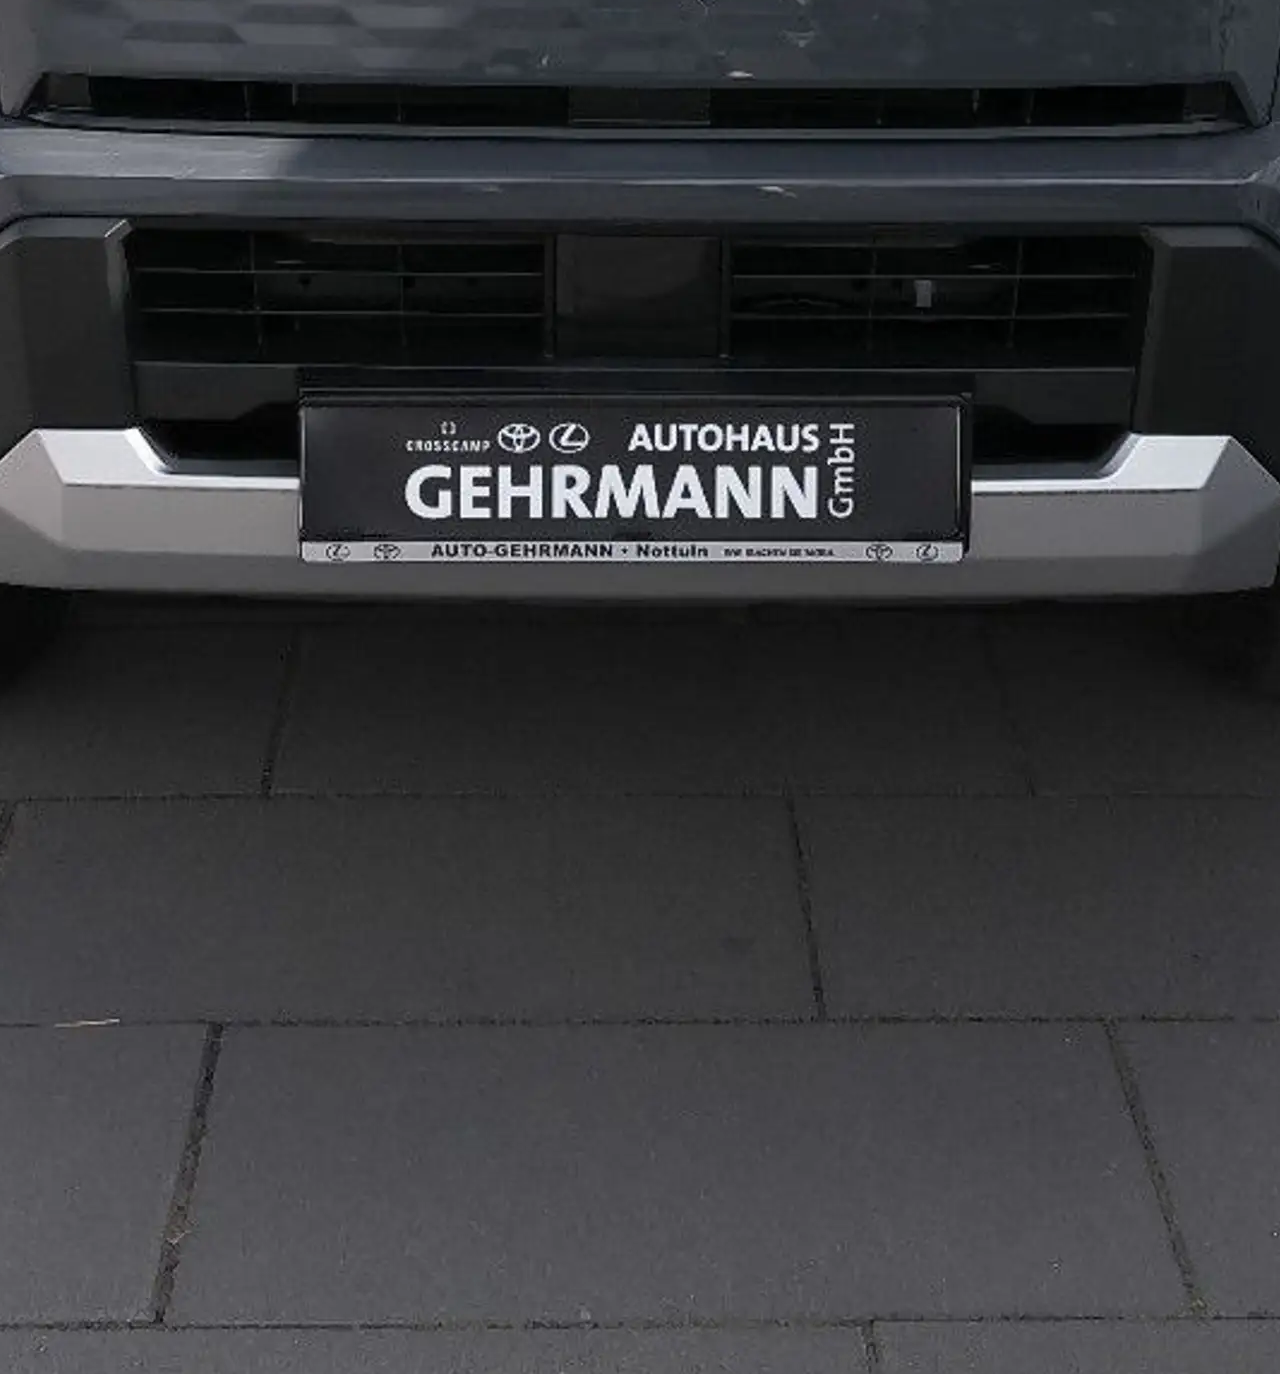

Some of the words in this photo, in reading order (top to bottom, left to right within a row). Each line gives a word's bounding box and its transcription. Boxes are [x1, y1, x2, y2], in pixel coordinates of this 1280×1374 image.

[406, 440, 490, 452] CROSSCAMP
[629, 424, 819, 452] AUTOHAUS
[827, 423, 855, 519] GmbH
[406, 465, 817, 518] GEHRMANN
[431, 543, 613, 558] AUTO-GEHRMANN
[636, 544, 708, 558] Nottuln
